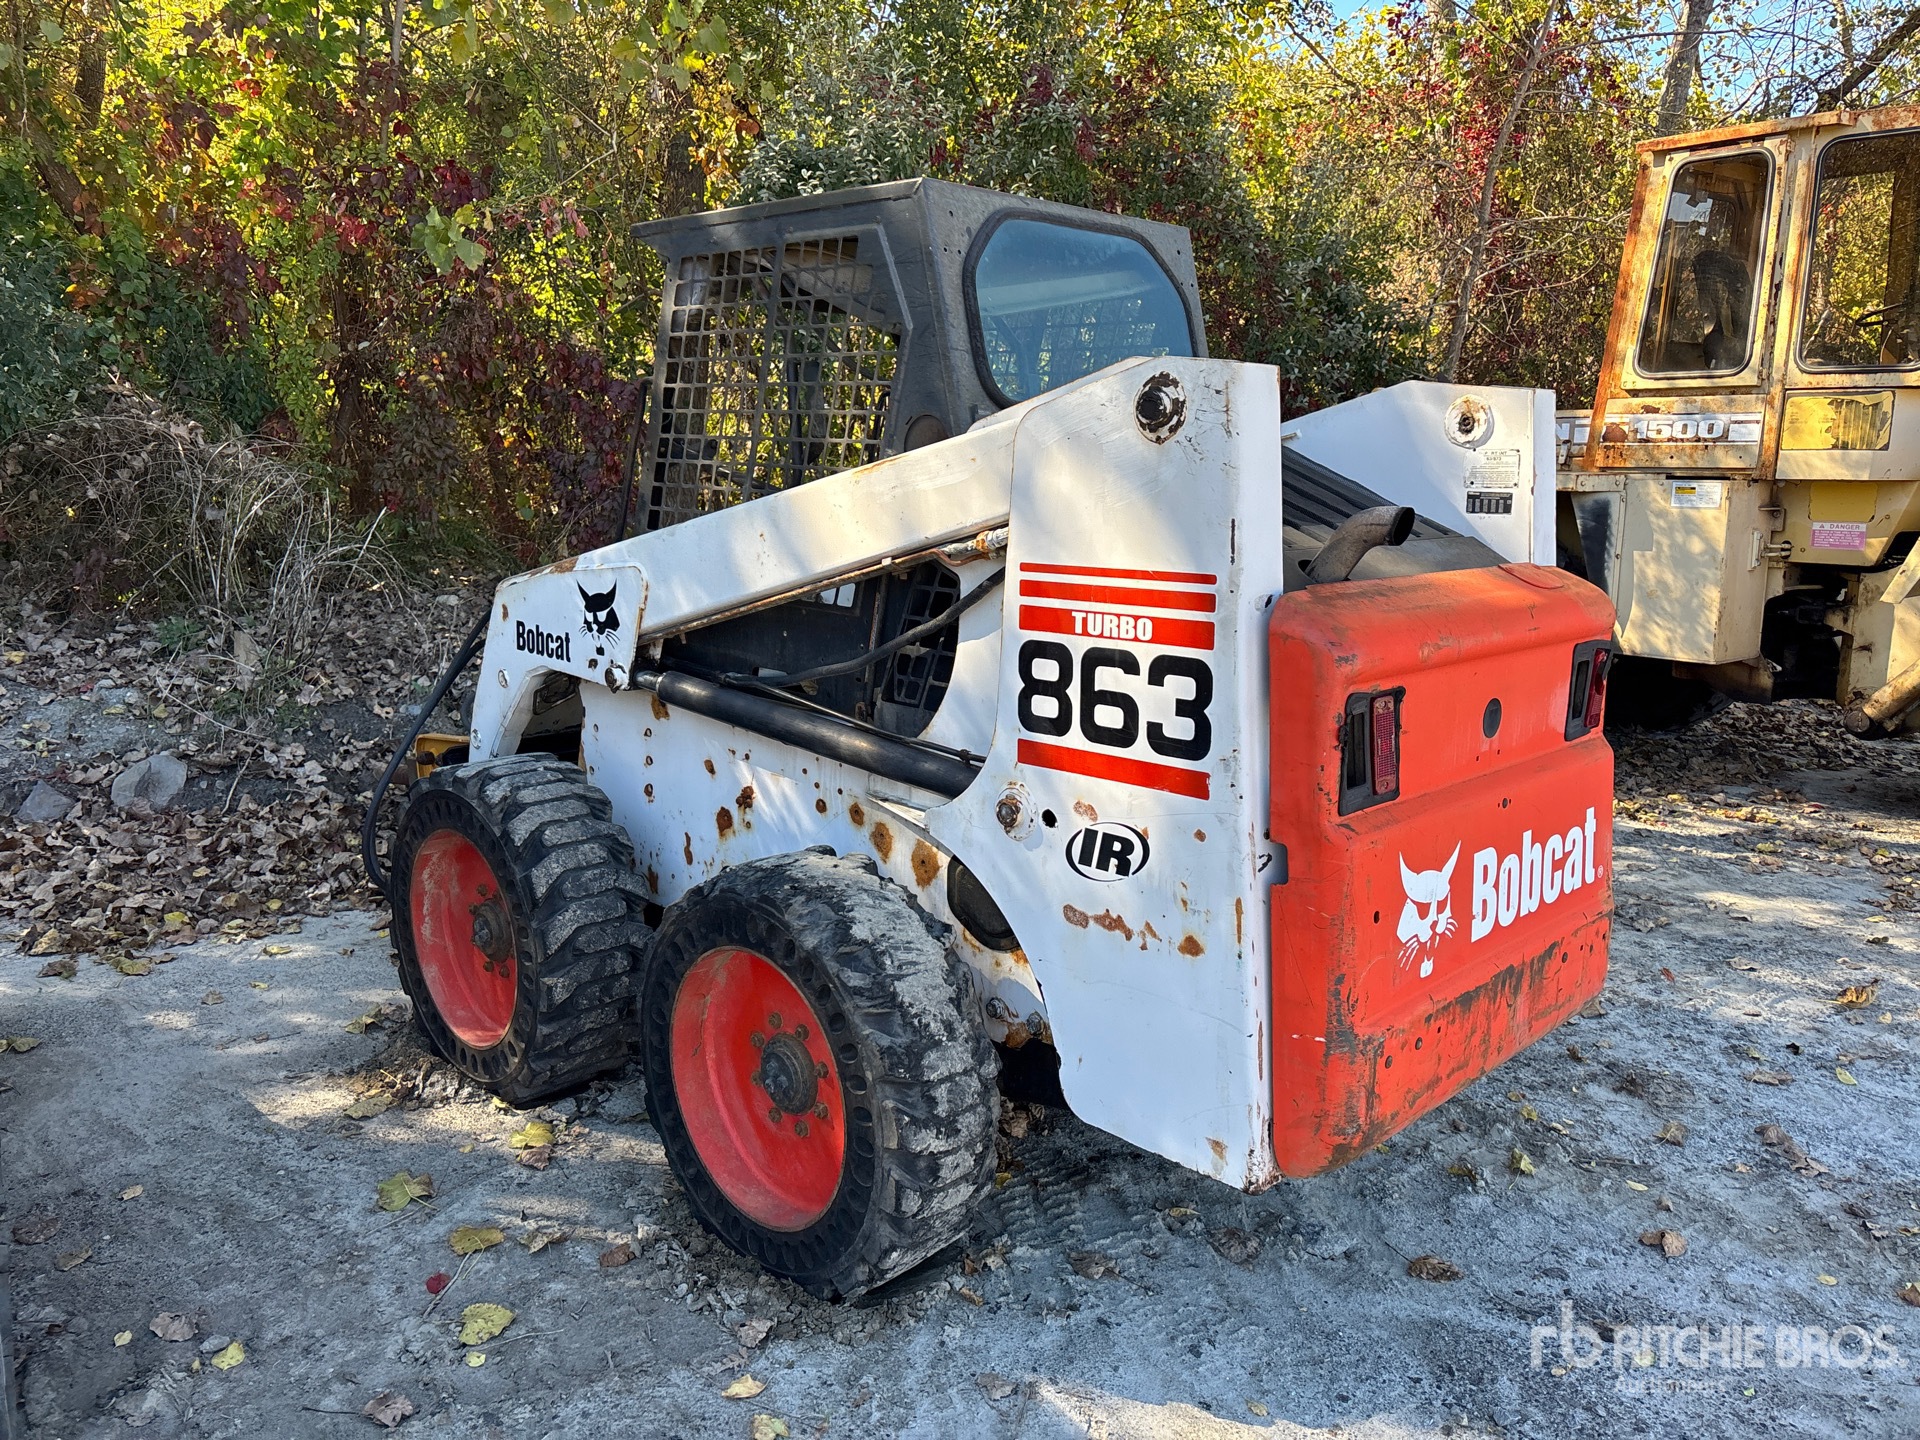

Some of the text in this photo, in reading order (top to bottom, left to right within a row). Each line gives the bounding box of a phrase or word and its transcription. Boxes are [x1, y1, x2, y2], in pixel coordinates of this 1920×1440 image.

[1634, 419, 1725, 439] 1500
[516, 620, 571, 663] Bobcat
[1072, 611, 1153, 642] TURBO
[1017, 639, 1214, 762] 863
[1077, 827, 1135, 877] IR
[1471, 806, 1597, 944] Bobcat
